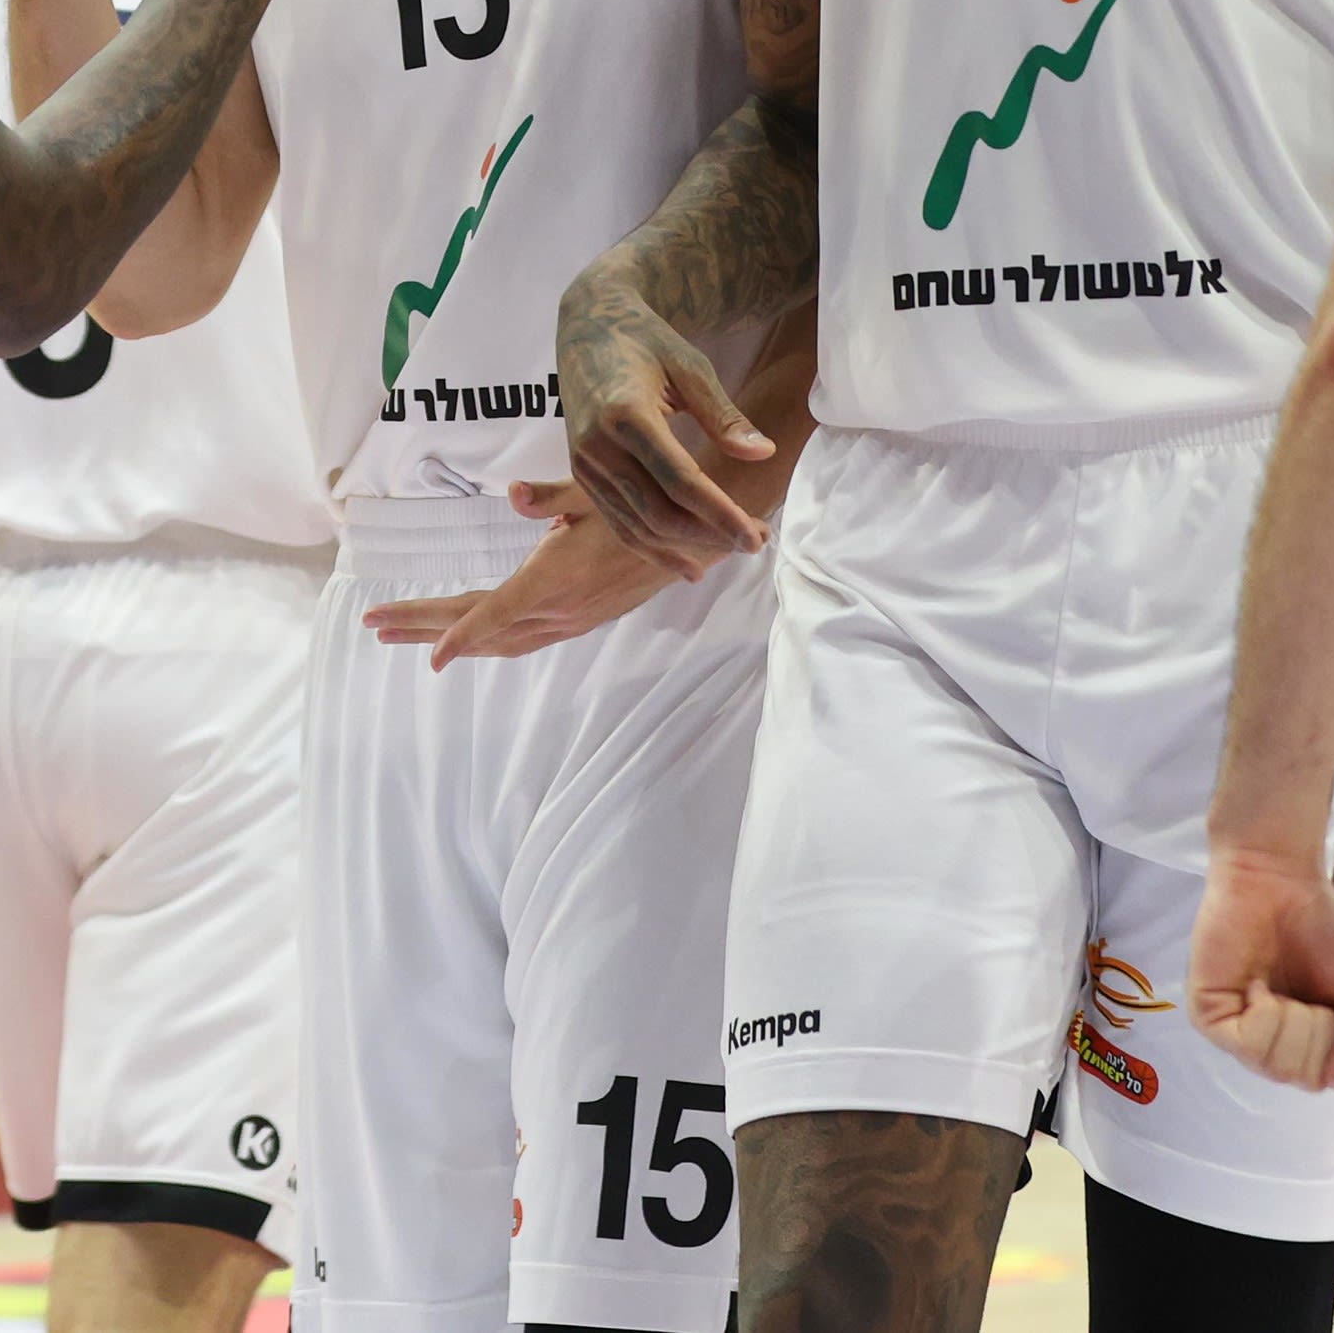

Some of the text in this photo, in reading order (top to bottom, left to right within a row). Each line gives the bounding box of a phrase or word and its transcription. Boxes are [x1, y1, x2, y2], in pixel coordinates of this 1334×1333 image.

[893, 250, 1228, 311] אלטשולר שחם
[728, 1009, 821, 1056] Kempa
[576, 1075, 734, 1248] 15
